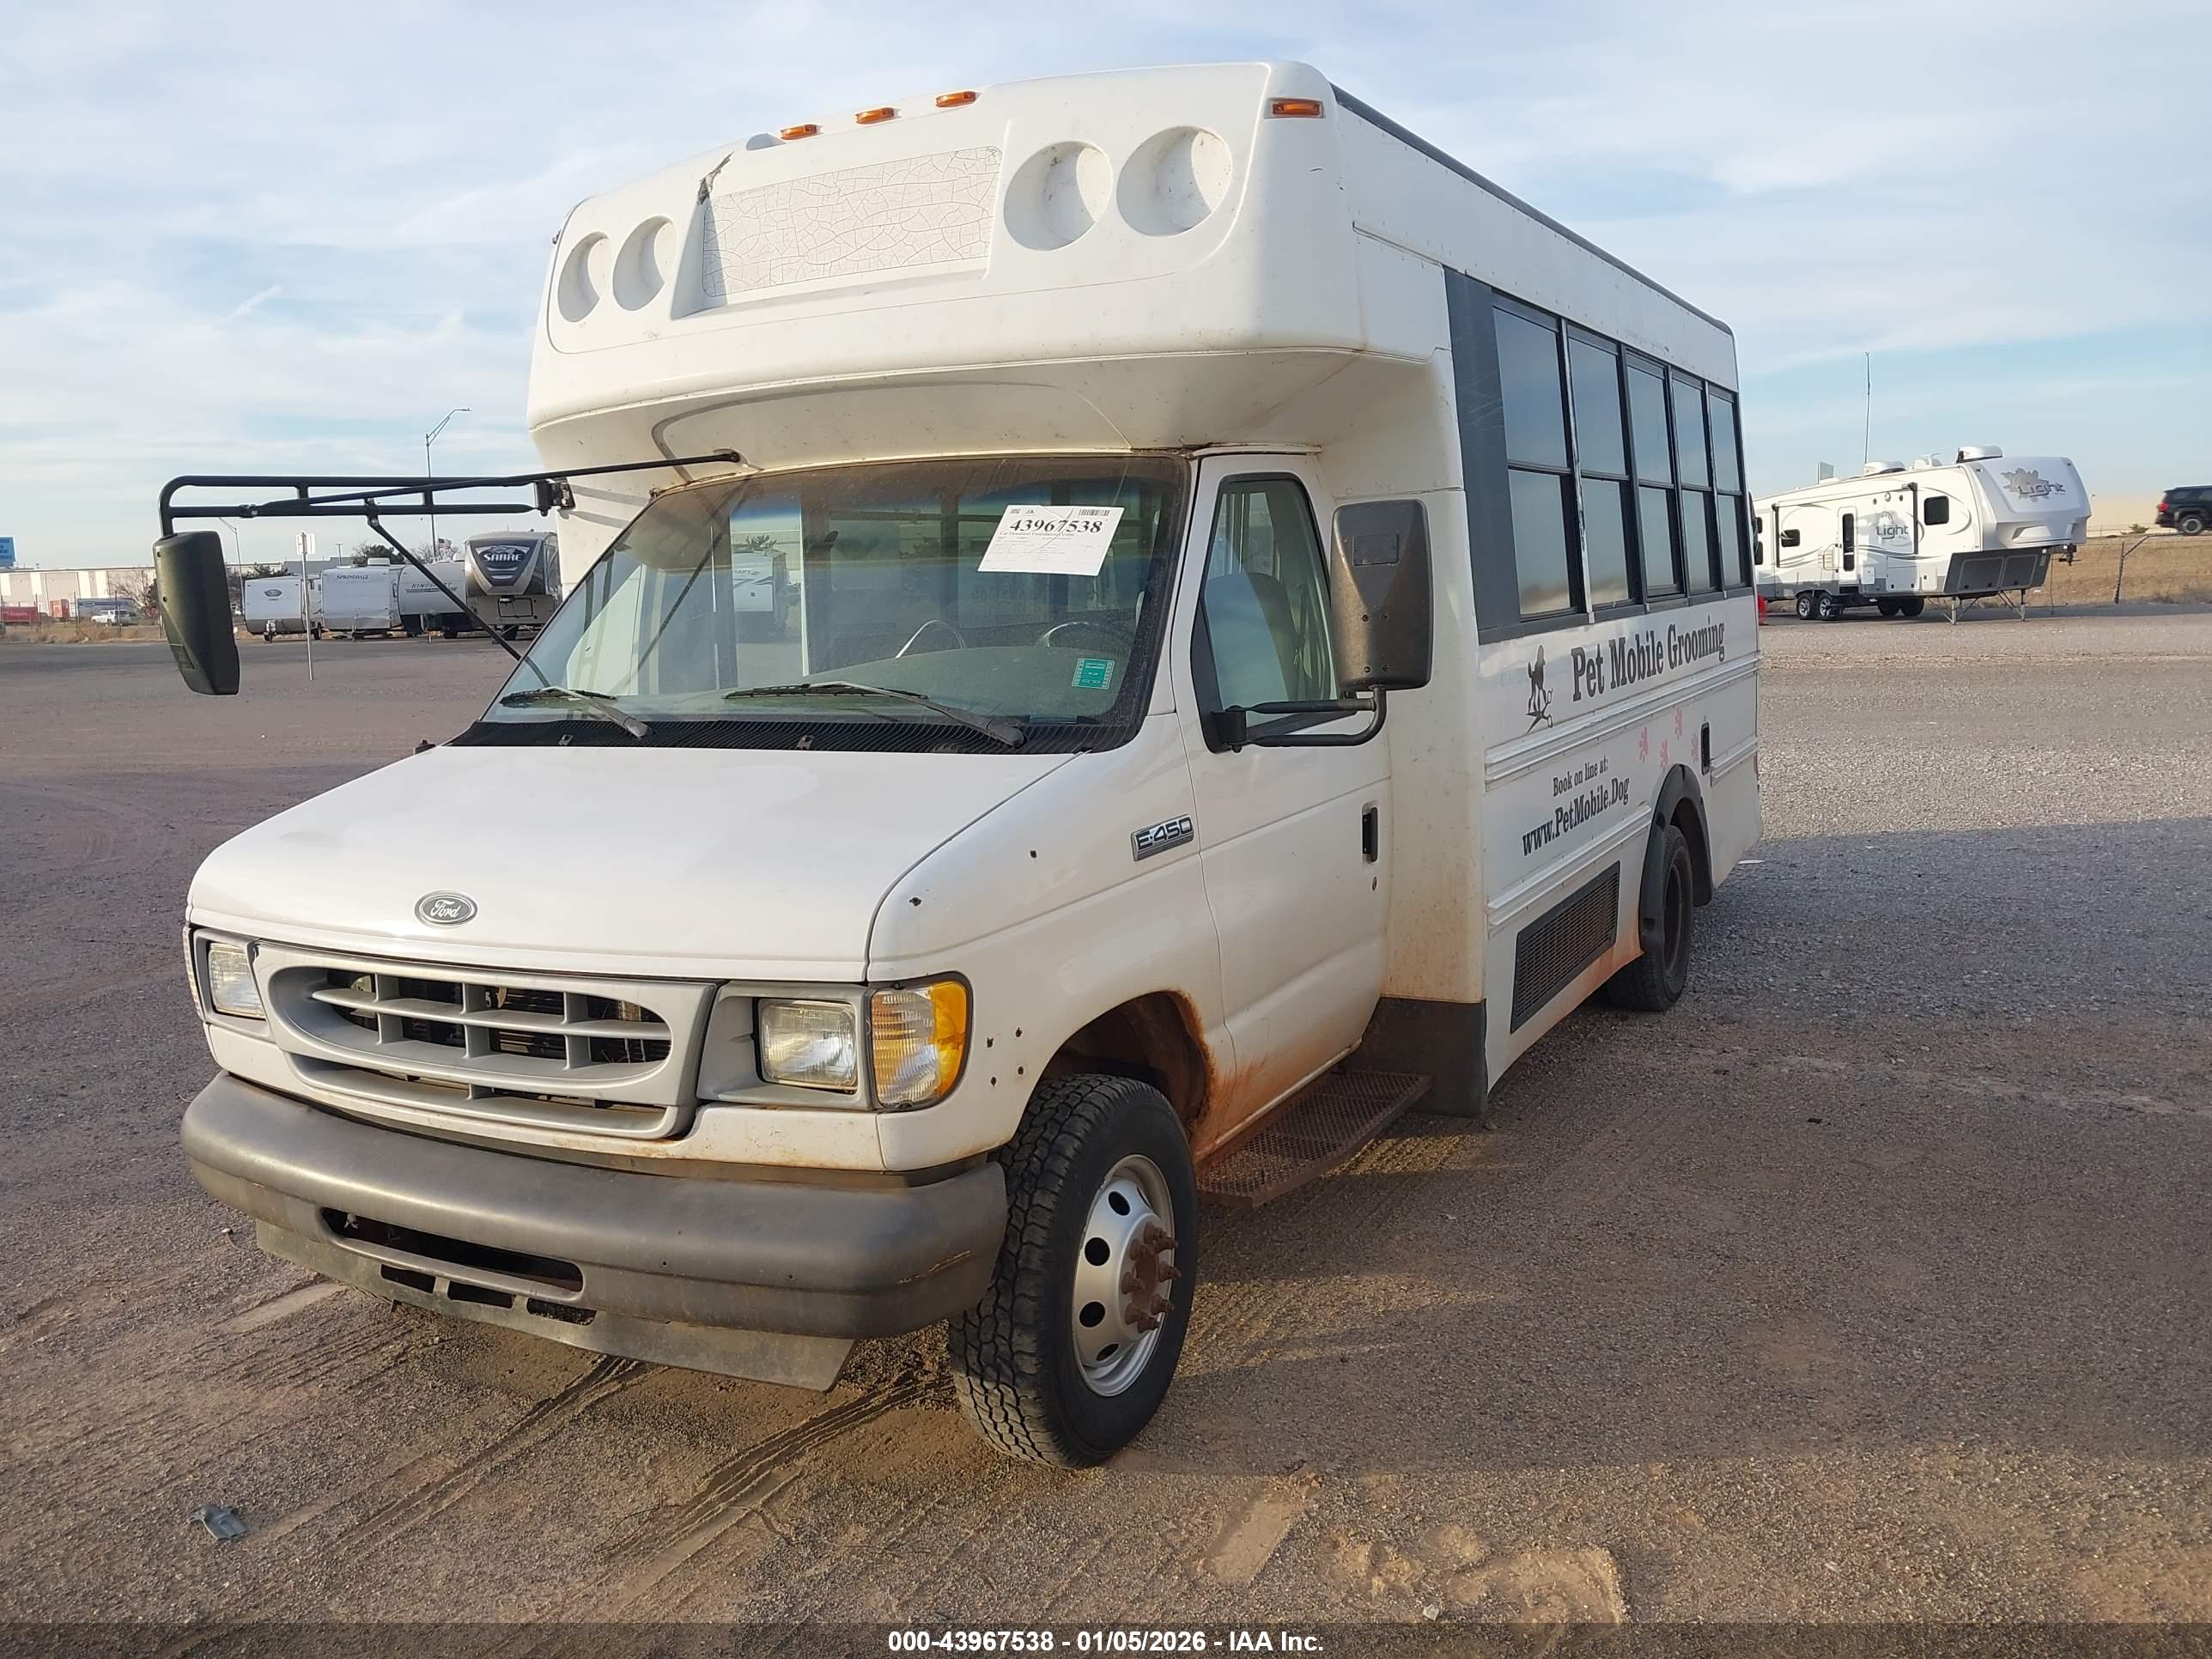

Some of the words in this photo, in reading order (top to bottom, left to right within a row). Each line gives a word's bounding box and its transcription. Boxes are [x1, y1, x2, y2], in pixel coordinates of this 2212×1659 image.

[1010, 519, 1103, 533] 43967538
[1876, 524, 1909, 539] Light
[483, 553, 522, 562] SABRE
[1571, 643, 1605, 702] Pet
[1608, 629, 1664, 690] Mobile
[1667, 614, 1725, 671] Grooming
[1553, 770, 1573, 798] Book
[1574, 769, 1583, 787] on
[1584, 762, 1598, 781] line
[1599, 755, 1608, 774] at:
[1522, 777, 1630, 857] www.PetMobile.Dog
[430, 899, 462, 918] Ford
